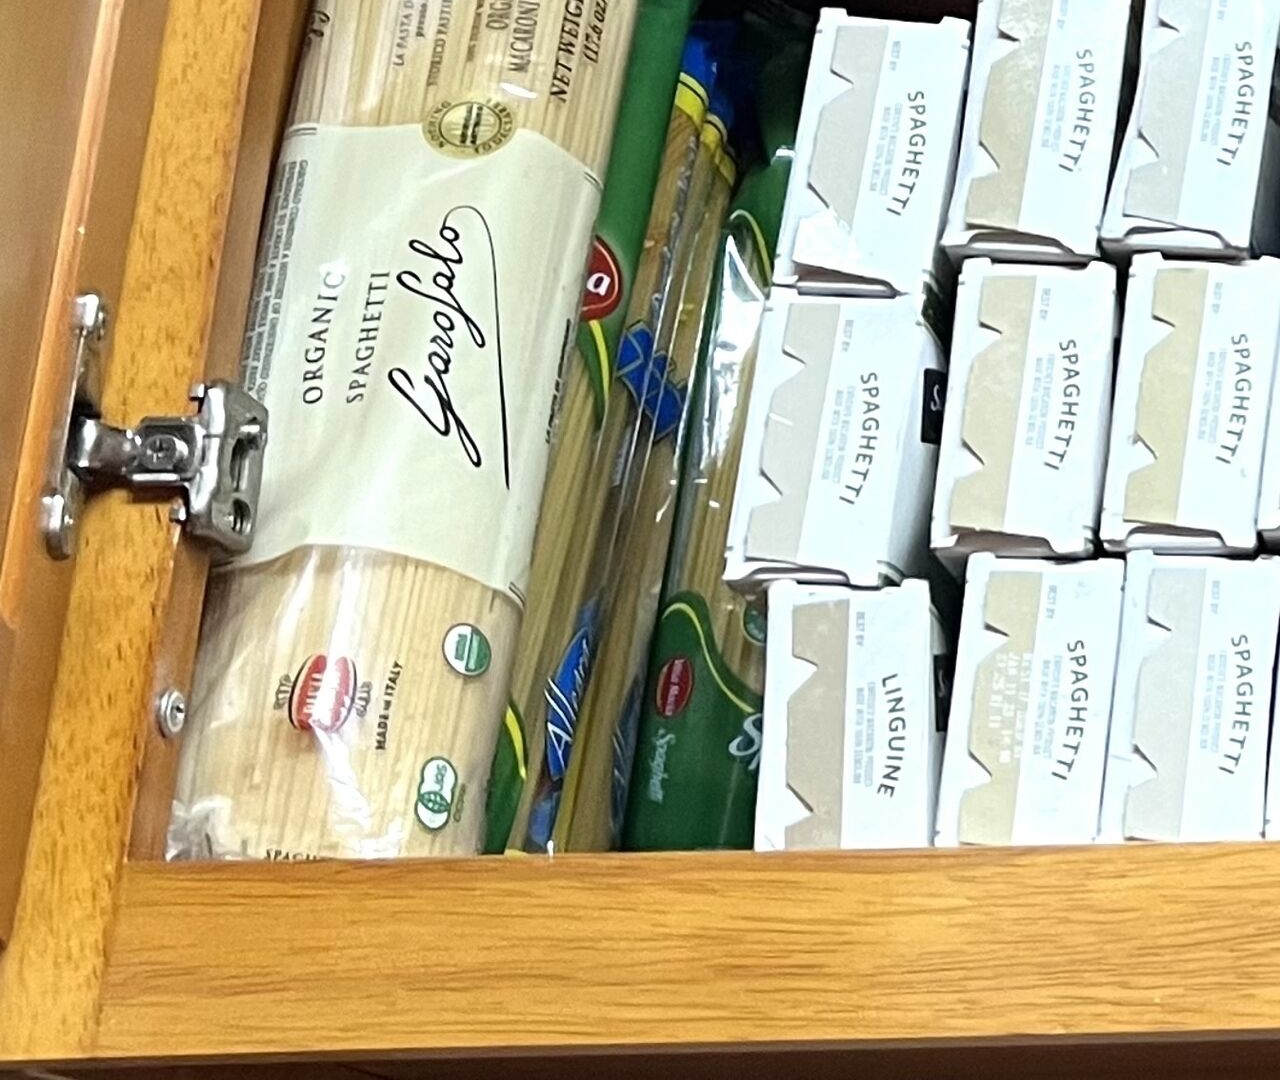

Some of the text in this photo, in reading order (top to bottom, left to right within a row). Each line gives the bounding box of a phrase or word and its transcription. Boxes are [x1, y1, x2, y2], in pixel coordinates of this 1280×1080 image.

[508, 0, 541, 73] MACARONI
[551, 59, 574, 104] NET
[583, 24, 604, 64] (17.6
[886, 91, 927, 216] SPAGHETTI
[1058, 49, 1096, 173] SPAGHETTI
[1216, 41, 1253, 166] SPAGHETTI
[303, 271, 346, 405] ORGANIC
[346, 271, 391, 404] SPAGHETTI
[388, 205, 508, 490] Garofalo
[1215, 334, 1252, 464] SPAGHETTI
[839, 372, 880, 504] SPAGHETTI
[1044, 339, 1081, 471] SPAGHETTI
[375, 709, 390, 751] MADE
[384, 659, 404, 698] ITALY
[877, 673, 907, 798] LINGUINE
[1051, 640, 1089, 780] SPAGHETTI
[1218, 635, 1254, 774] SPAGHETTI
